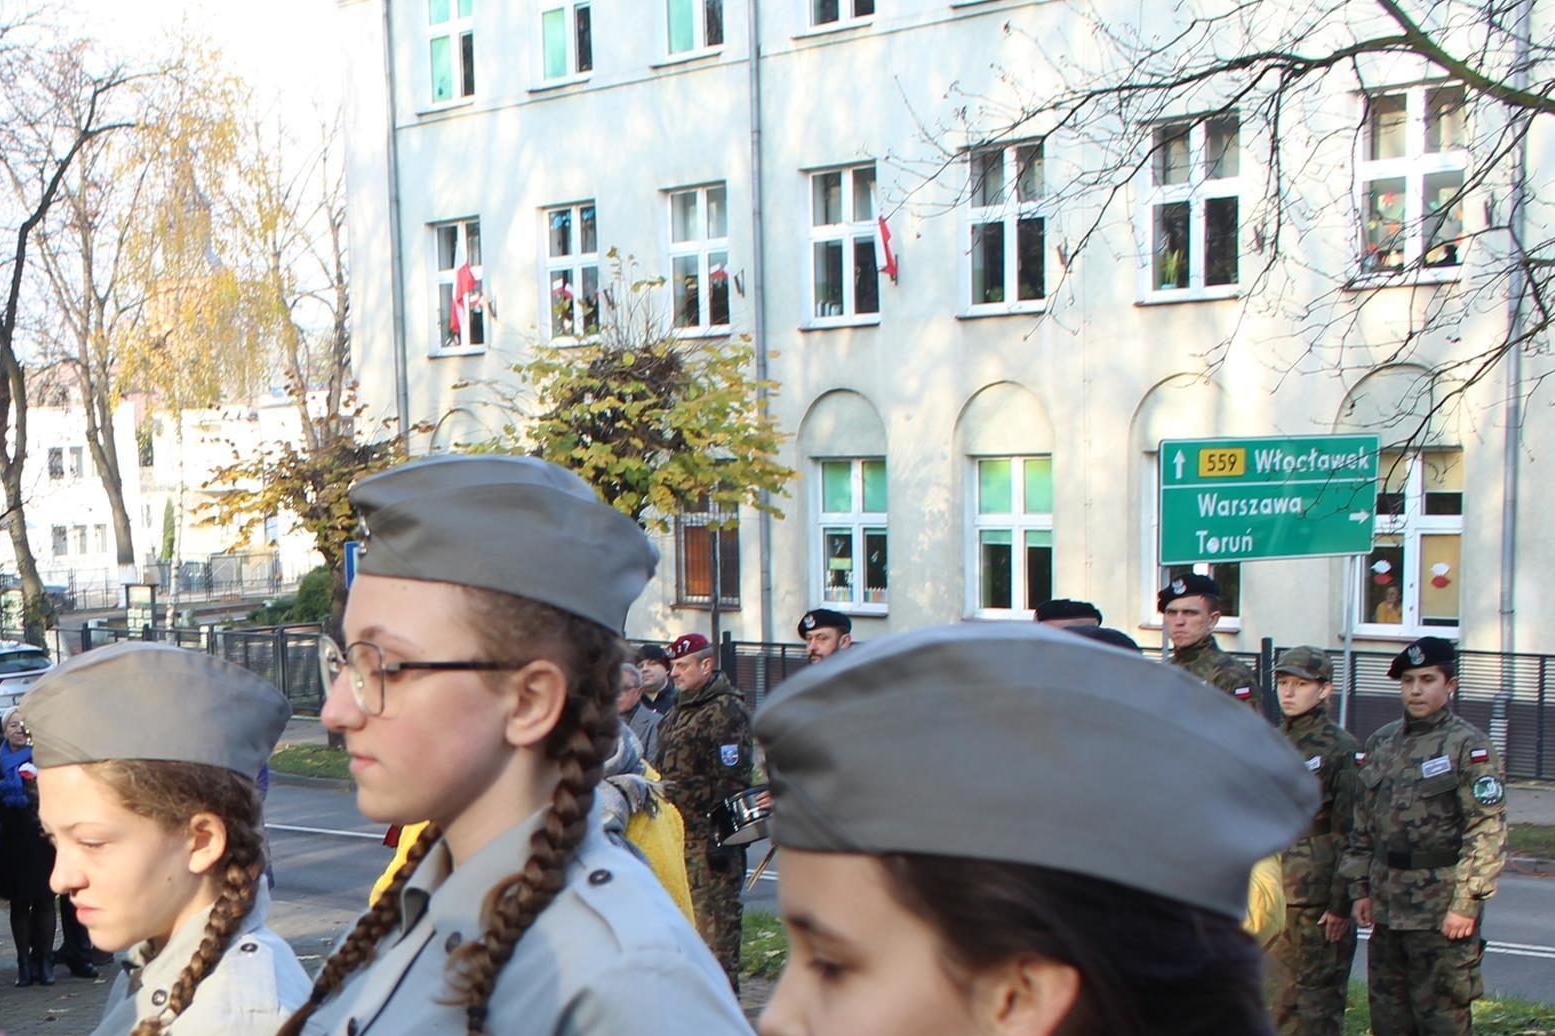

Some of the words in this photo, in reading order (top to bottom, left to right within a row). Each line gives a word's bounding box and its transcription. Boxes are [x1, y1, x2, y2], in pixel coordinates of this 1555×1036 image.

[1207, 453, 1238, 472] 559
[1254, 446, 1371, 473] Włocławek
[1197, 492, 1303, 518] Warszawa
[1195, 528, 1254, 555] Toruń
